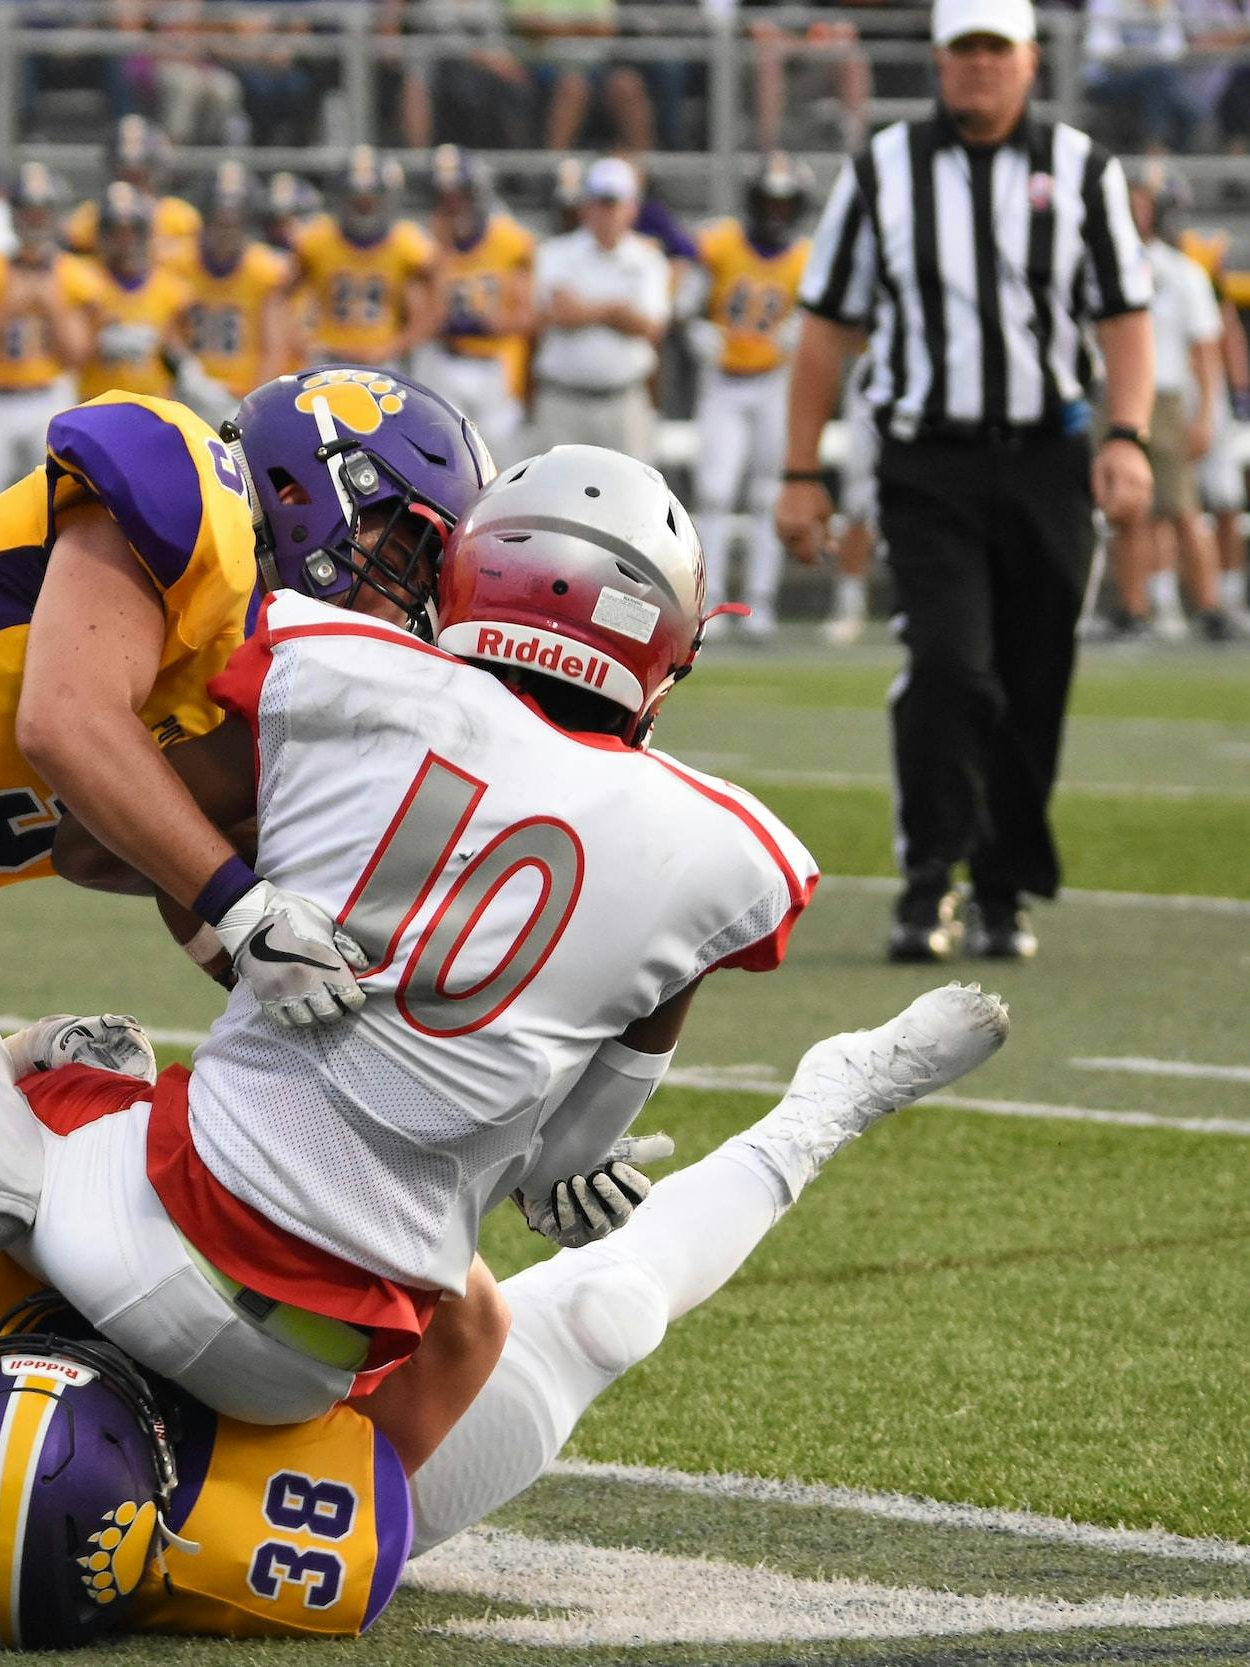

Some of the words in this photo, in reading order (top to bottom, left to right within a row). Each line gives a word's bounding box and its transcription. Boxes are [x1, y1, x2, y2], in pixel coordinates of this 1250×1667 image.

[476, 628, 610, 689] Riddell
[150, 713, 186, 745] PO
[335, 748, 586, 1039] 10
[9, 1359, 79, 1381] Riddell
[246, 1468, 360, 1611] 38
